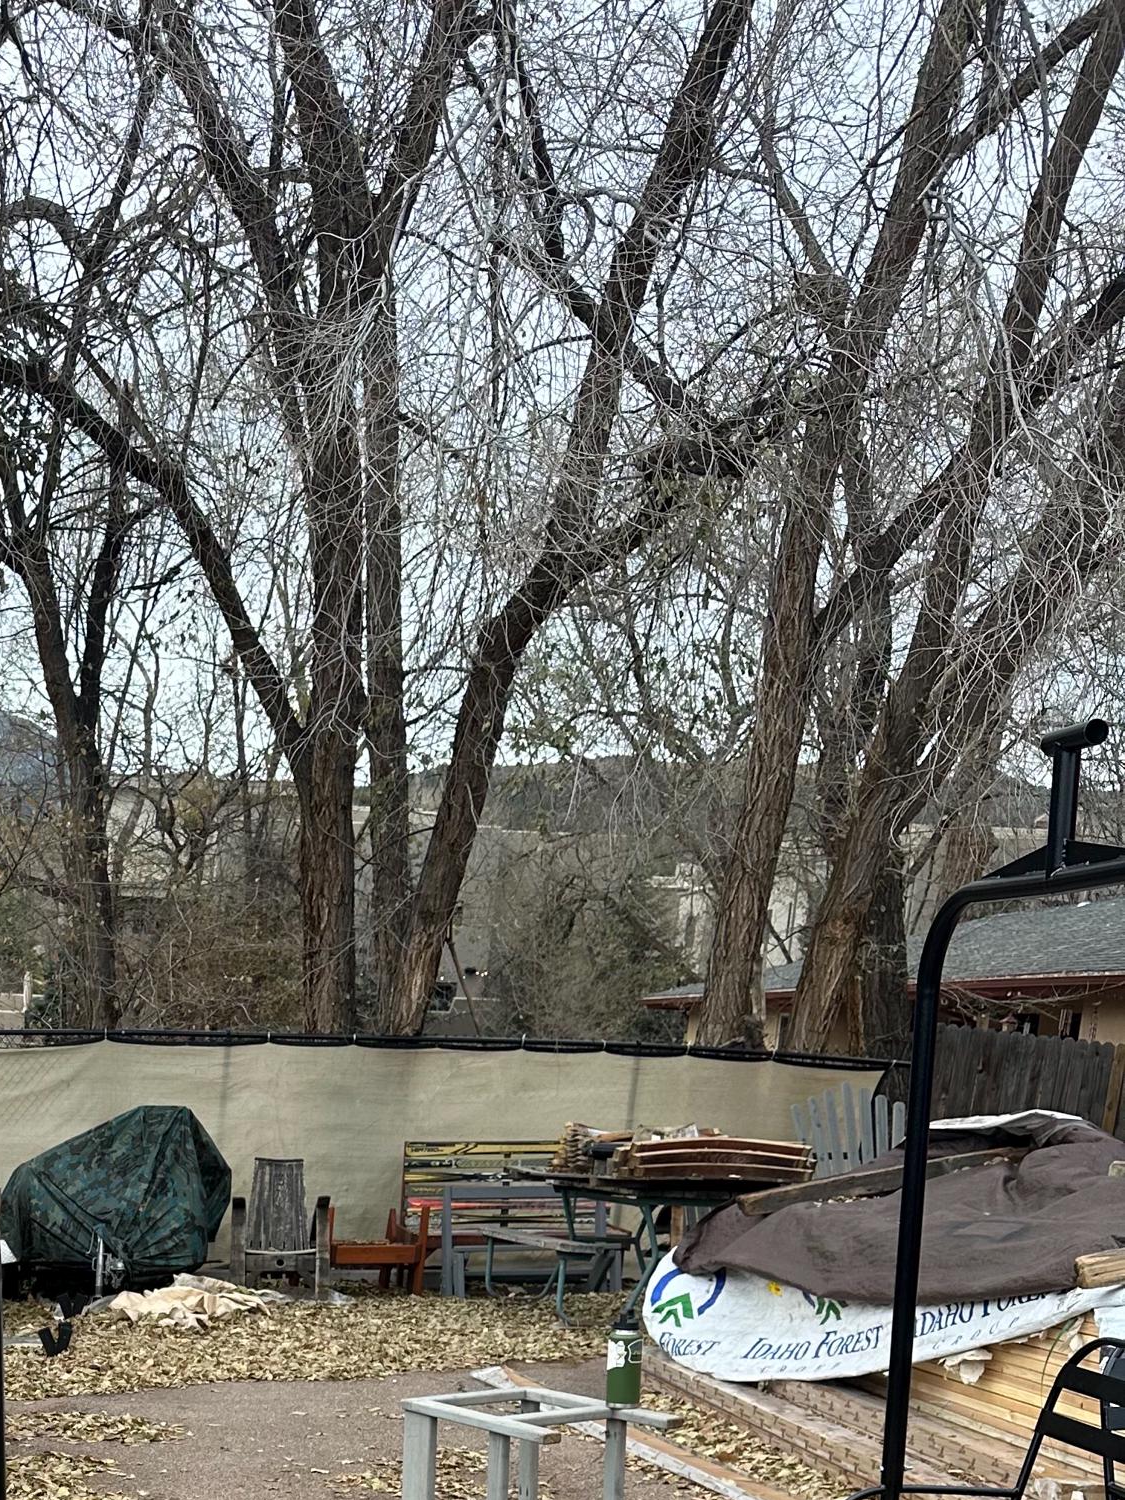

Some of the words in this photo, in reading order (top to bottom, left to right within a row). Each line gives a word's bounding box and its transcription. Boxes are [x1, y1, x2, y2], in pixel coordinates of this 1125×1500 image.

[913, 1301, 974, 1338] DAHO
[659, 1332, 721, 1356] FOREST
[741, 1337, 811, 1360] IDAHO
[811, 1325, 884, 1360] FOREST
